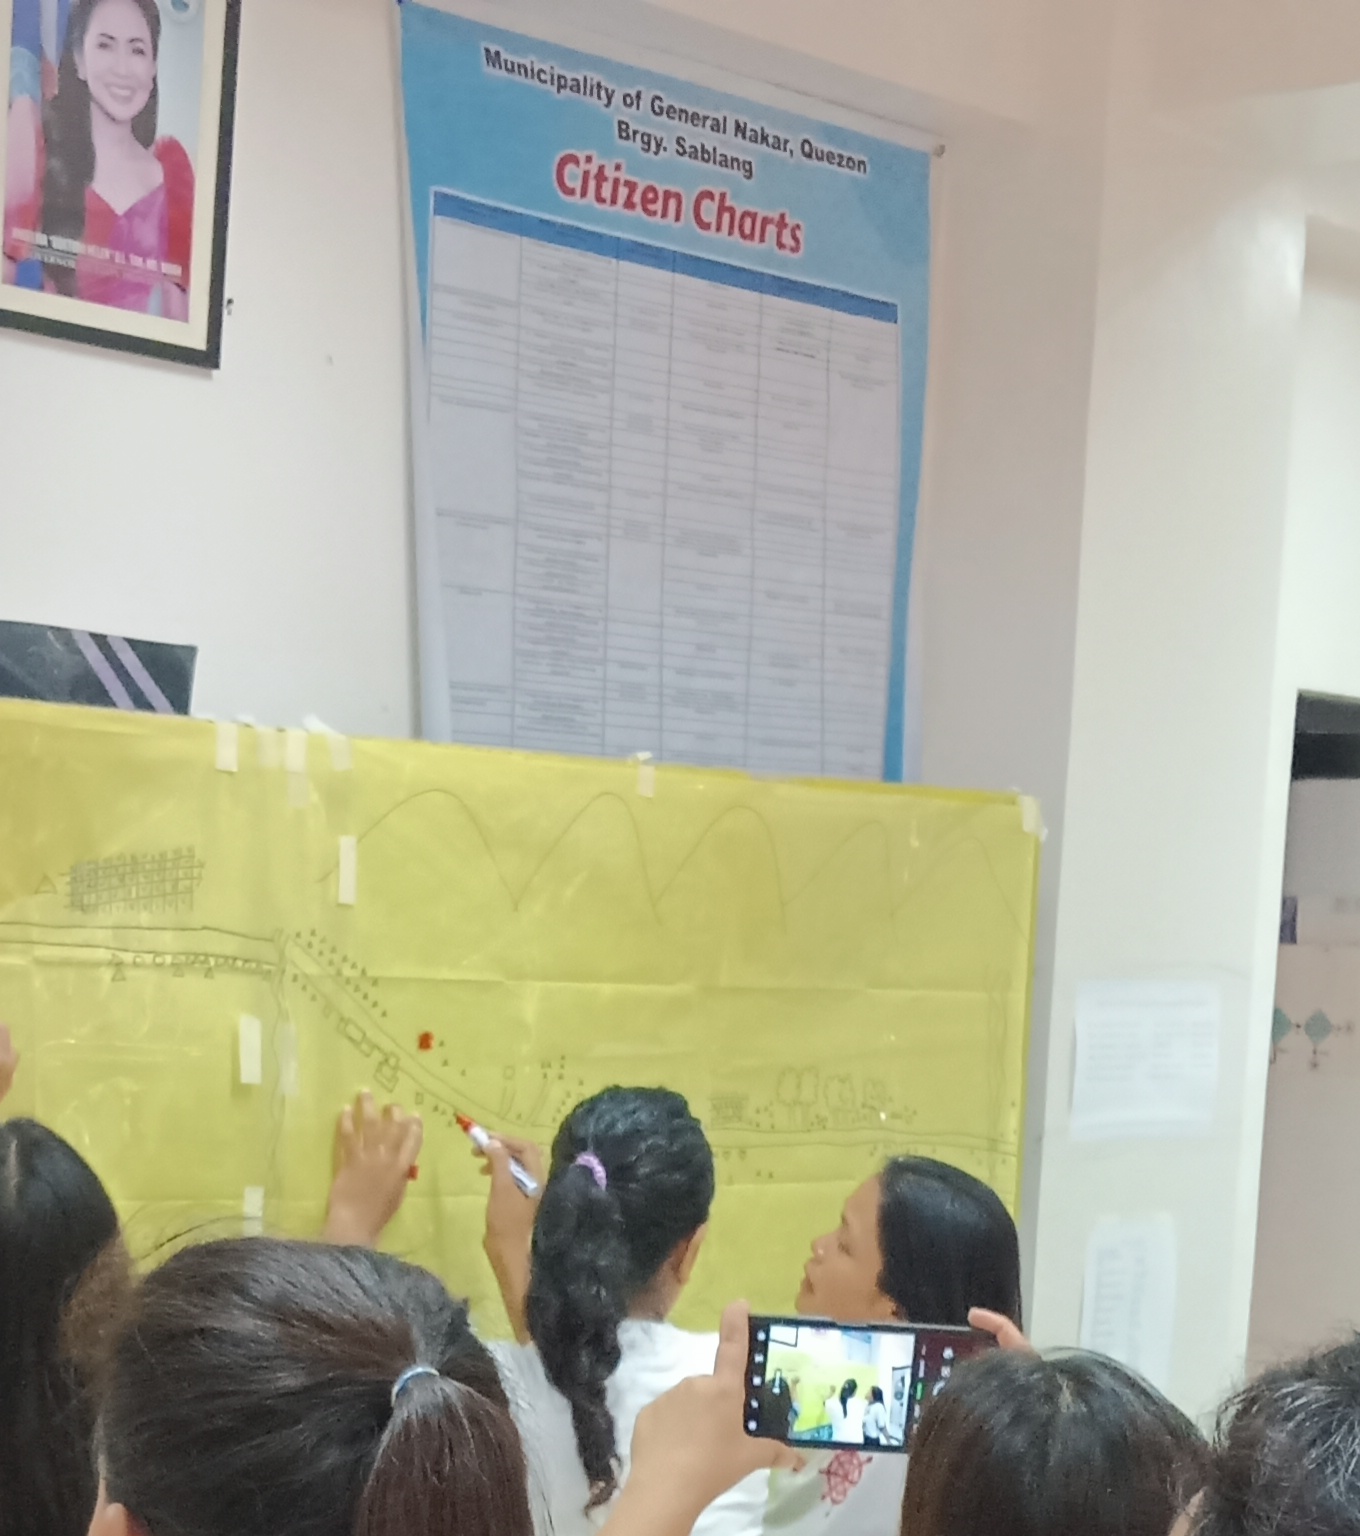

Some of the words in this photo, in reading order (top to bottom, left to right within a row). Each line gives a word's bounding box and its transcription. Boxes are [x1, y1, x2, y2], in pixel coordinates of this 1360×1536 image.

[483, 46, 616, 107] Municipality
[622, 88, 644, 110] of
[650, 94, 728, 136] General
[734, 120, 794, 157] Nakar,
[800, 138, 868, 174] Quezon
[616, 119, 668, 155] Brgy.
[675, 136, 754, 180] Sablang
[554, 153, 683, 224] Citizen
[692, 189, 803, 254] Charts
